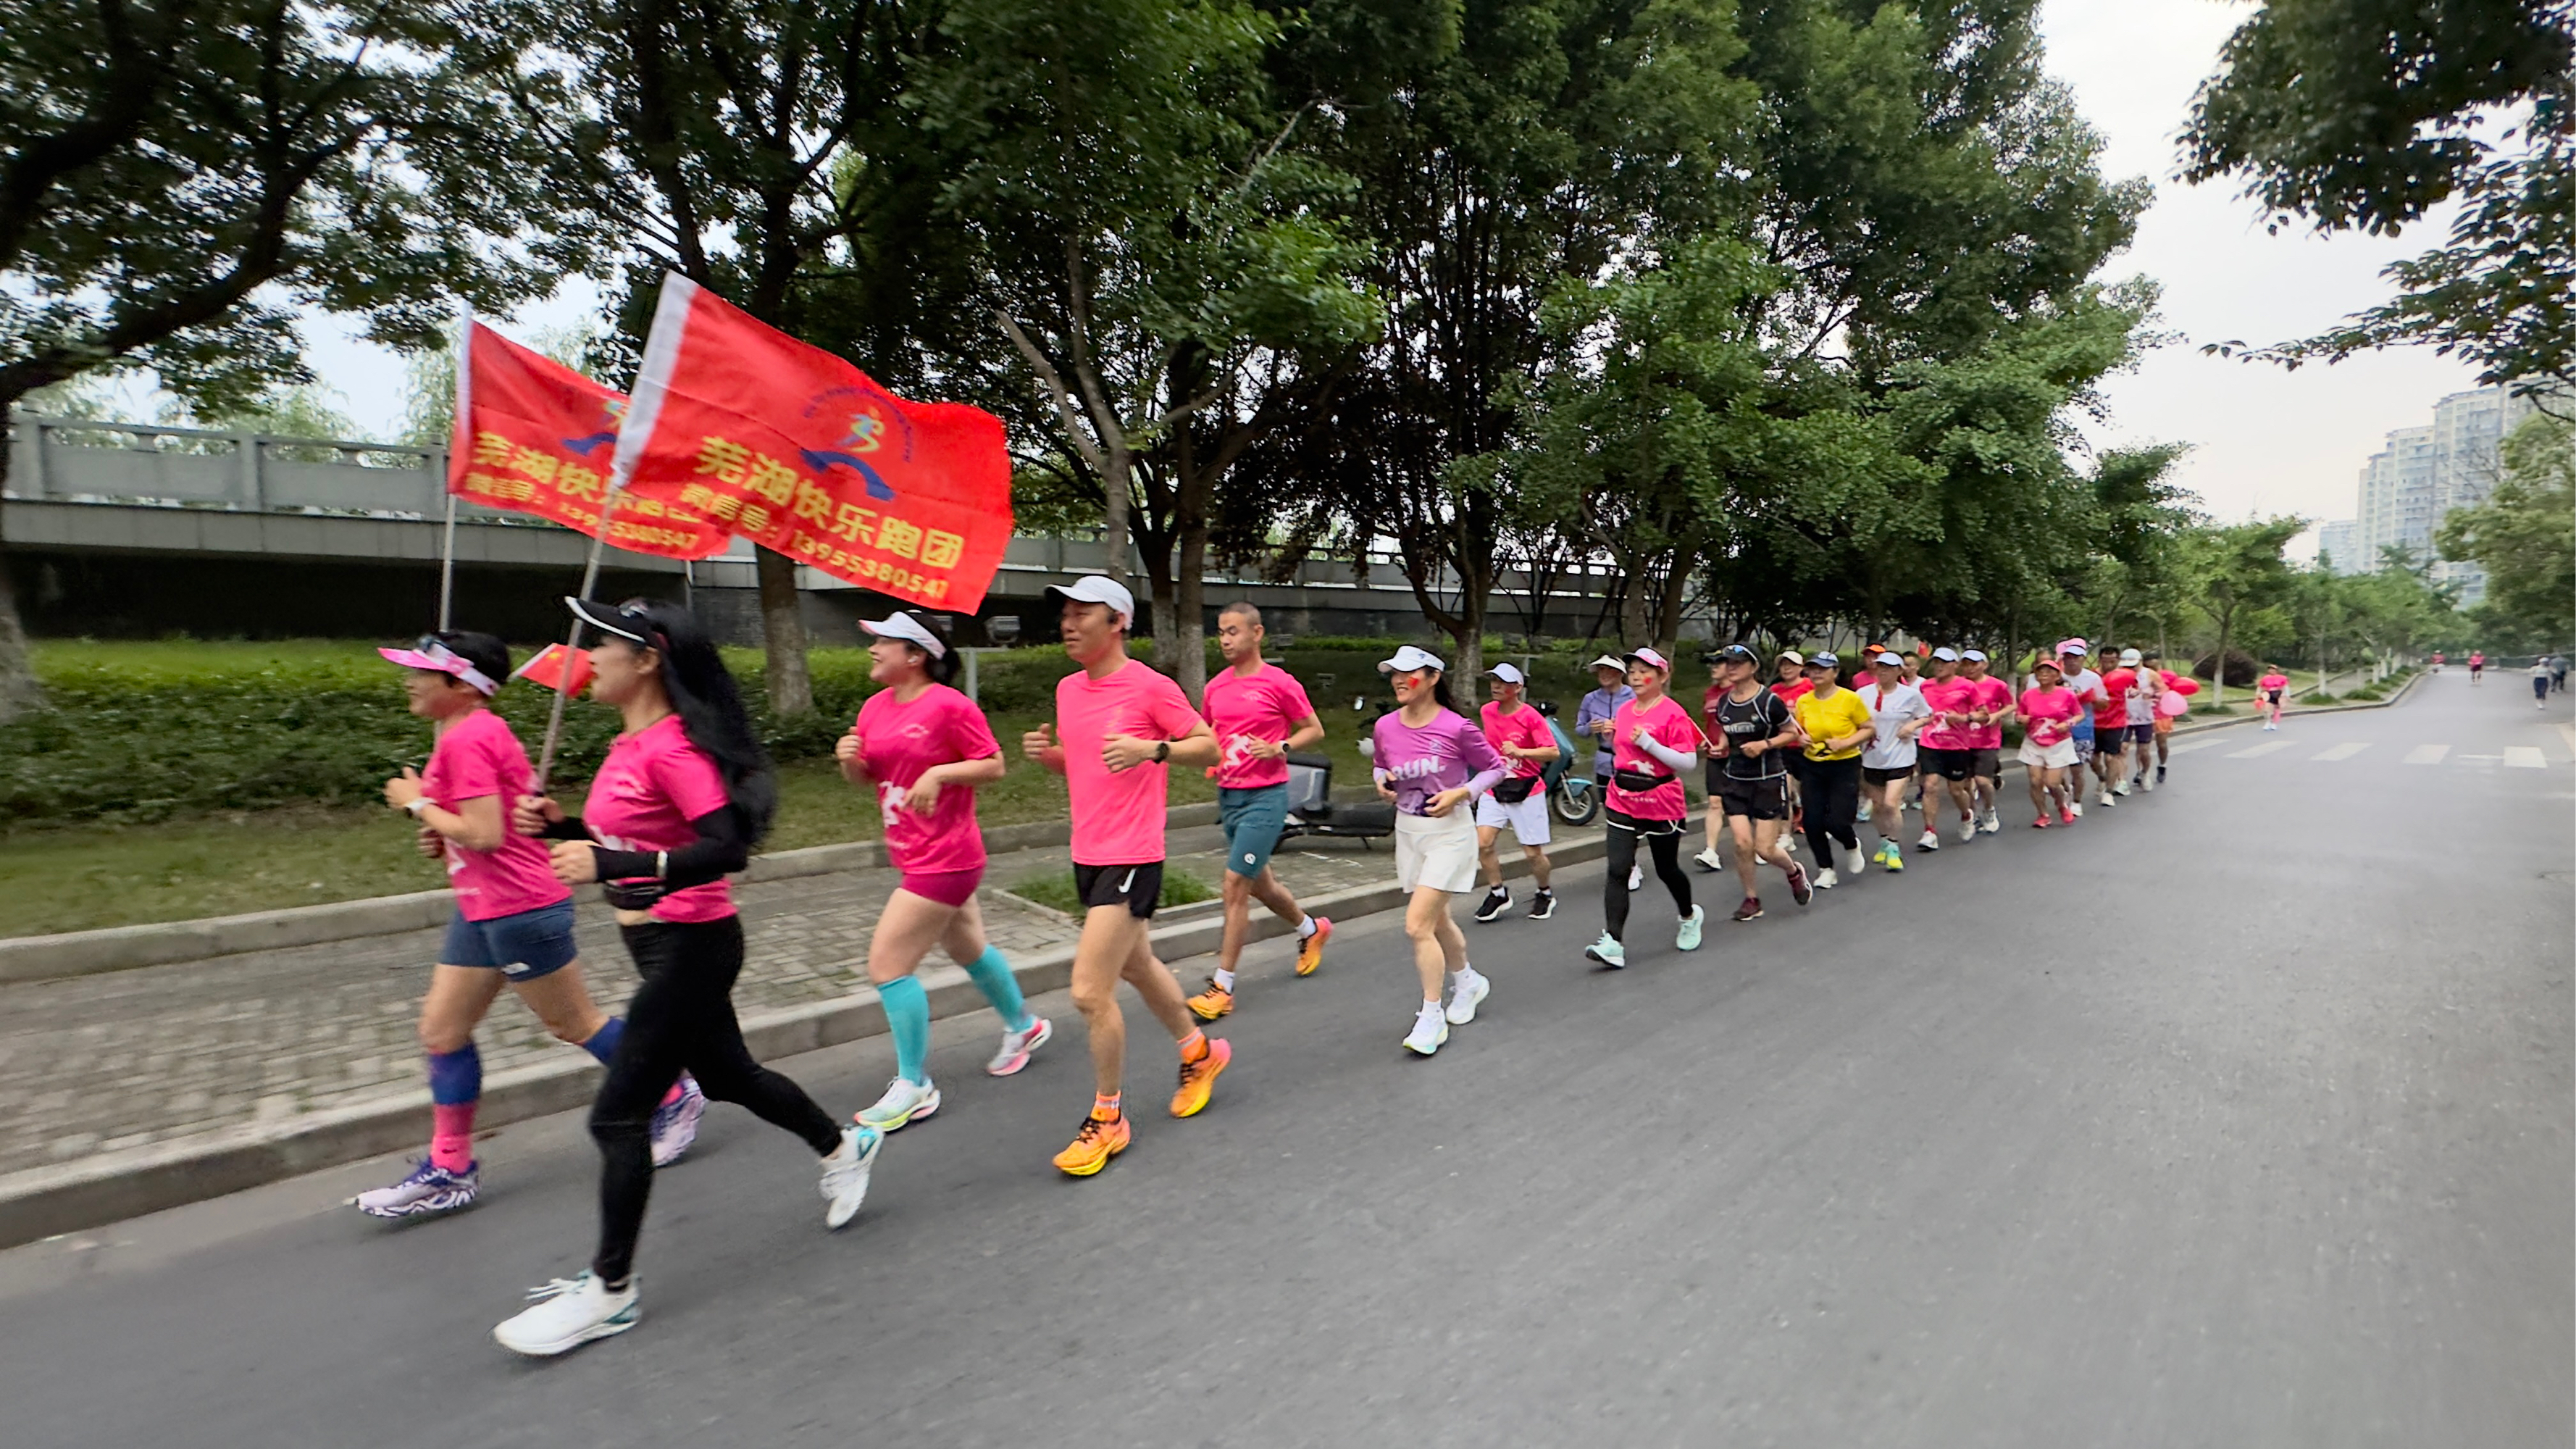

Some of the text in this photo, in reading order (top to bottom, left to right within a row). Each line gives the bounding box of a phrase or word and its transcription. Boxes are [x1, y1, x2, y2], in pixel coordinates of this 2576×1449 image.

[693, 435, 964, 570] 芜湖快乐跑团
